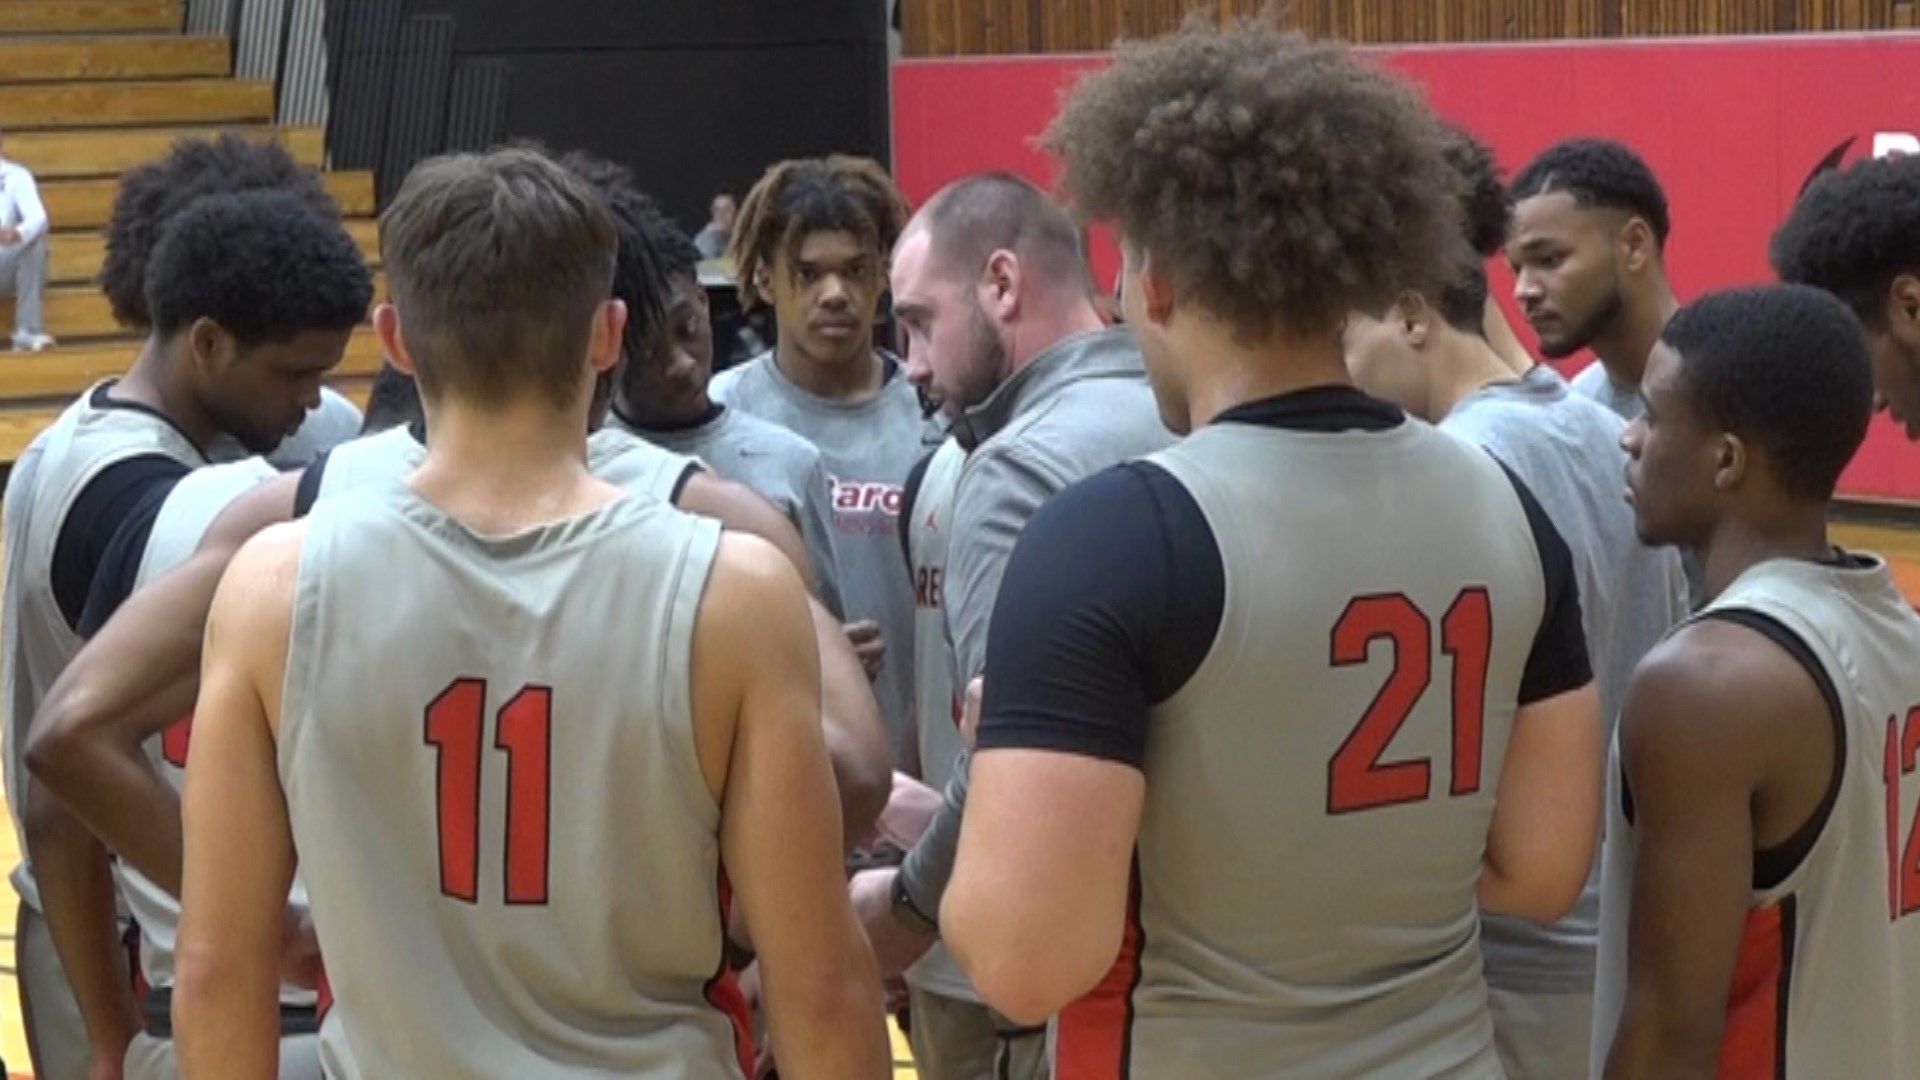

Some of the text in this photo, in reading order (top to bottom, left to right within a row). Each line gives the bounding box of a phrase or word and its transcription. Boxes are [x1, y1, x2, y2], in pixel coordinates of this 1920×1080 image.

[827, 474, 905, 515] aro
[424, 677, 552, 905] 11
[1327, 586, 1492, 814] 21
